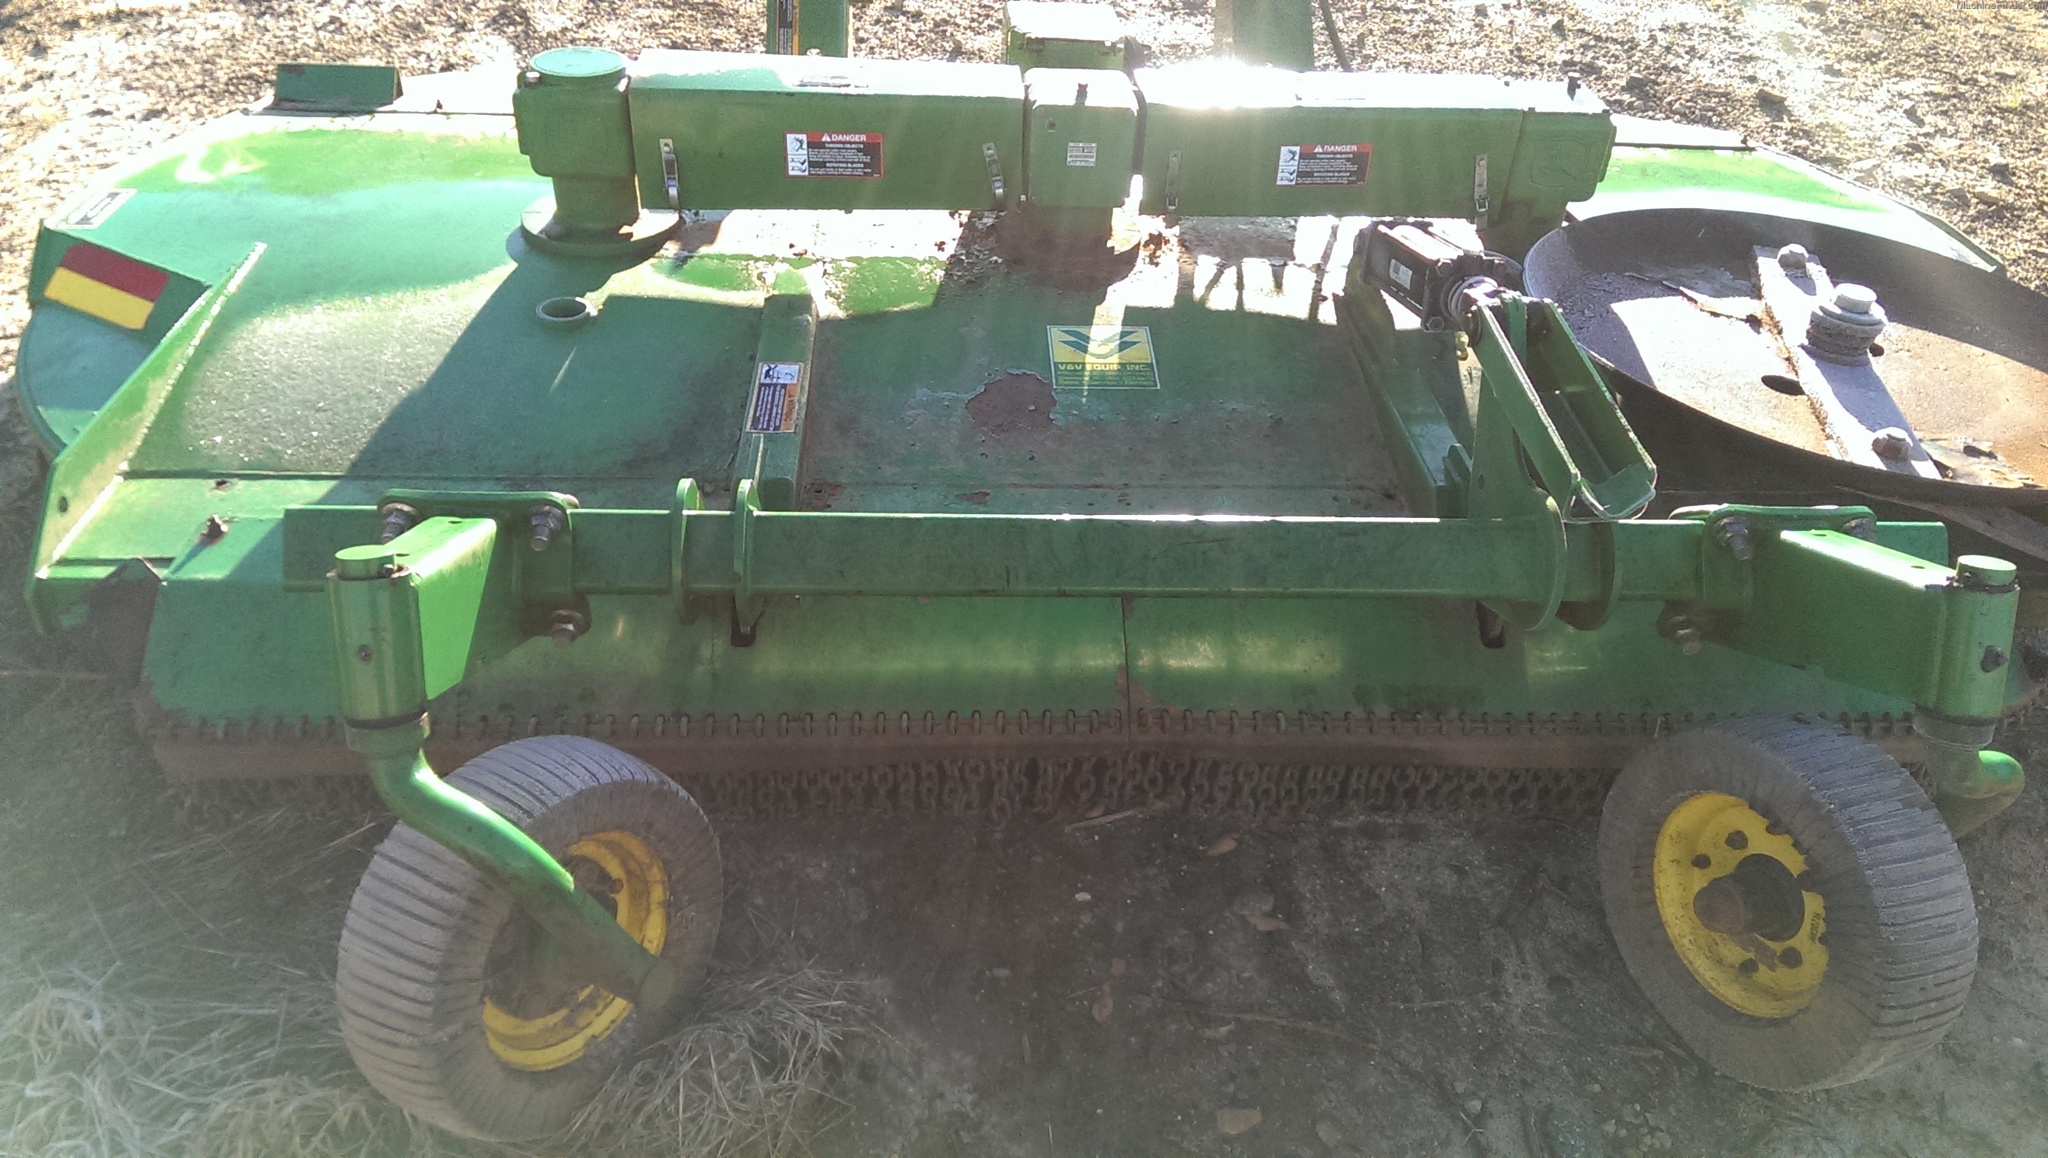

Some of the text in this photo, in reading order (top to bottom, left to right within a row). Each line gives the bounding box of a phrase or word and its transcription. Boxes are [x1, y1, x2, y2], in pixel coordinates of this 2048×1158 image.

[831, 134, 867, 142] DANGER
[1323, 144, 1358, 152] DANGER
[1058, 363, 1082, 371] V&V
